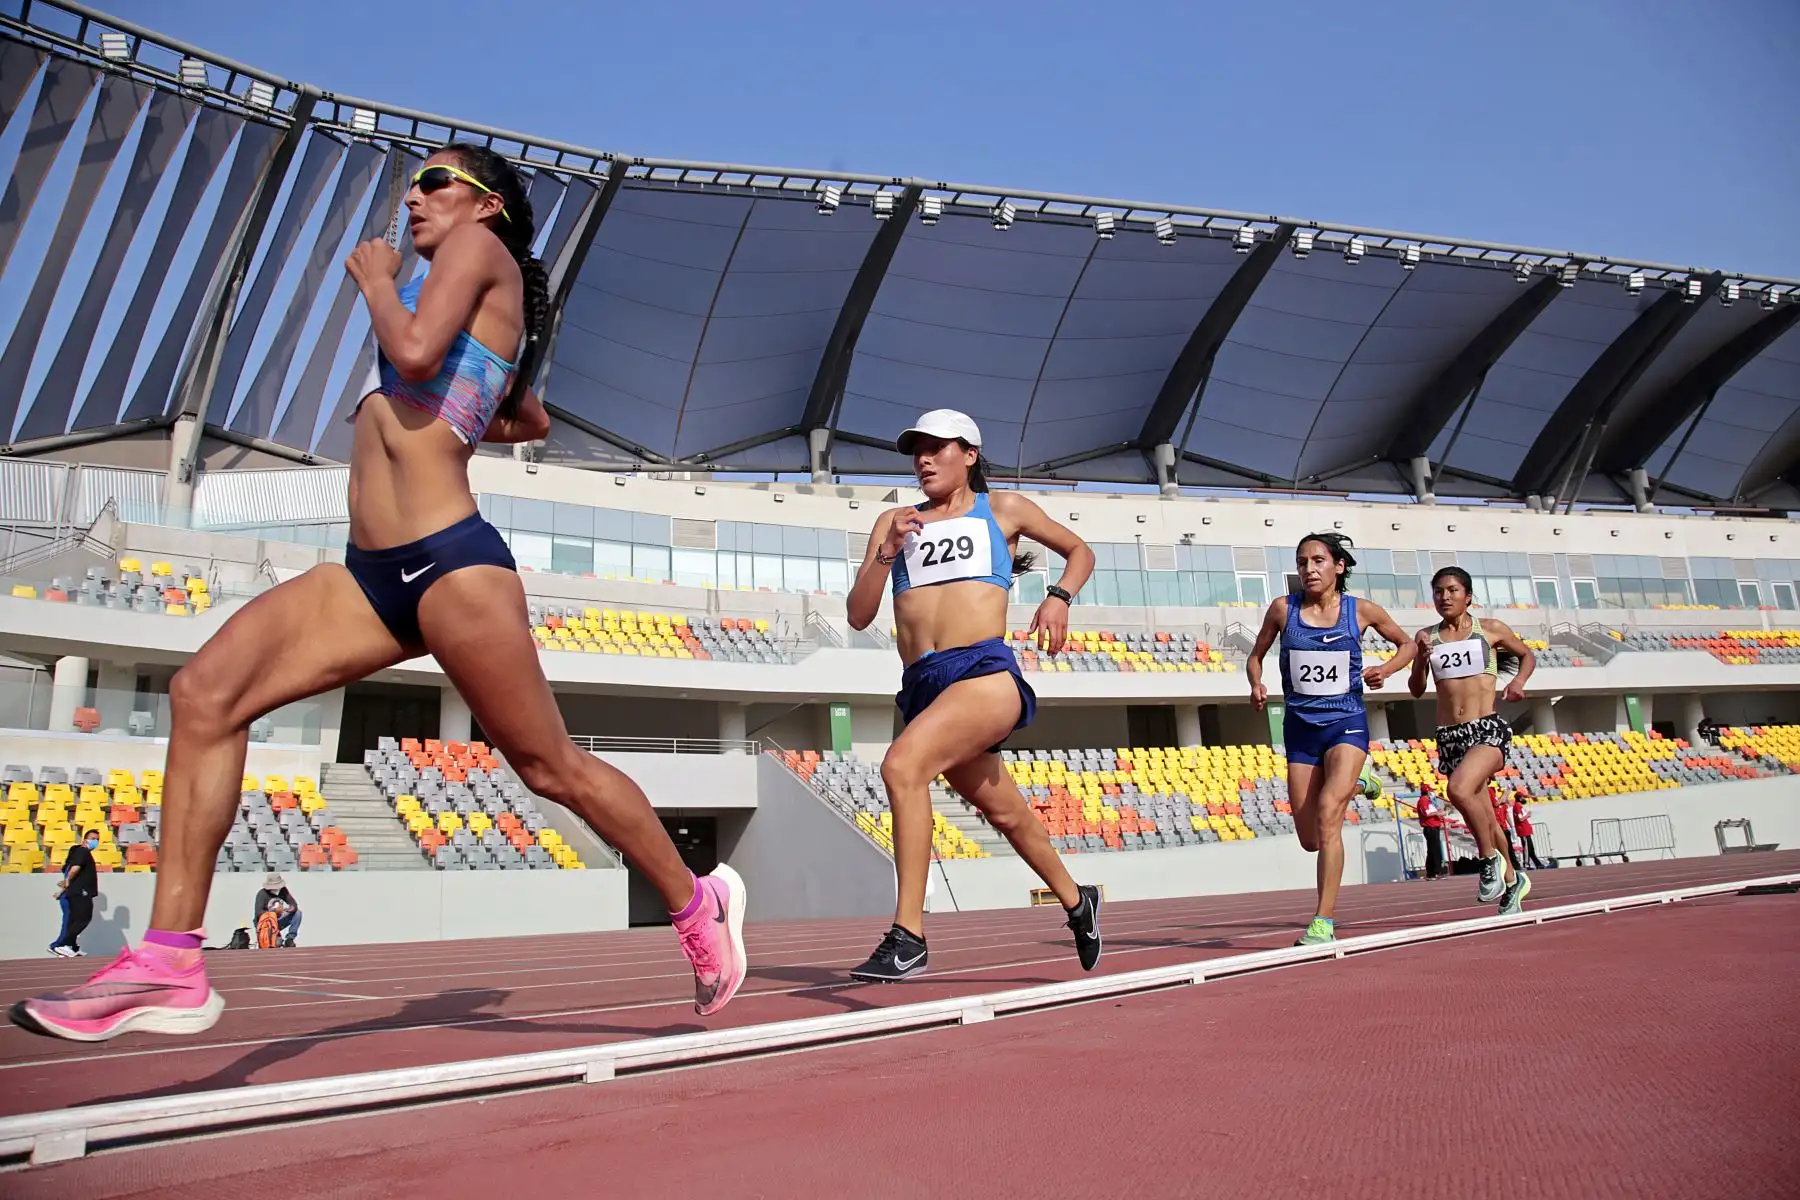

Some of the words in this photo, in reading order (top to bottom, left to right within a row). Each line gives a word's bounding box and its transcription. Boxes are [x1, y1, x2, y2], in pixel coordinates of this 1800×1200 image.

[919, 535, 974, 567] 229
[1440, 650, 1472, 669] 231
[1299, 664, 1338, 683] 234
